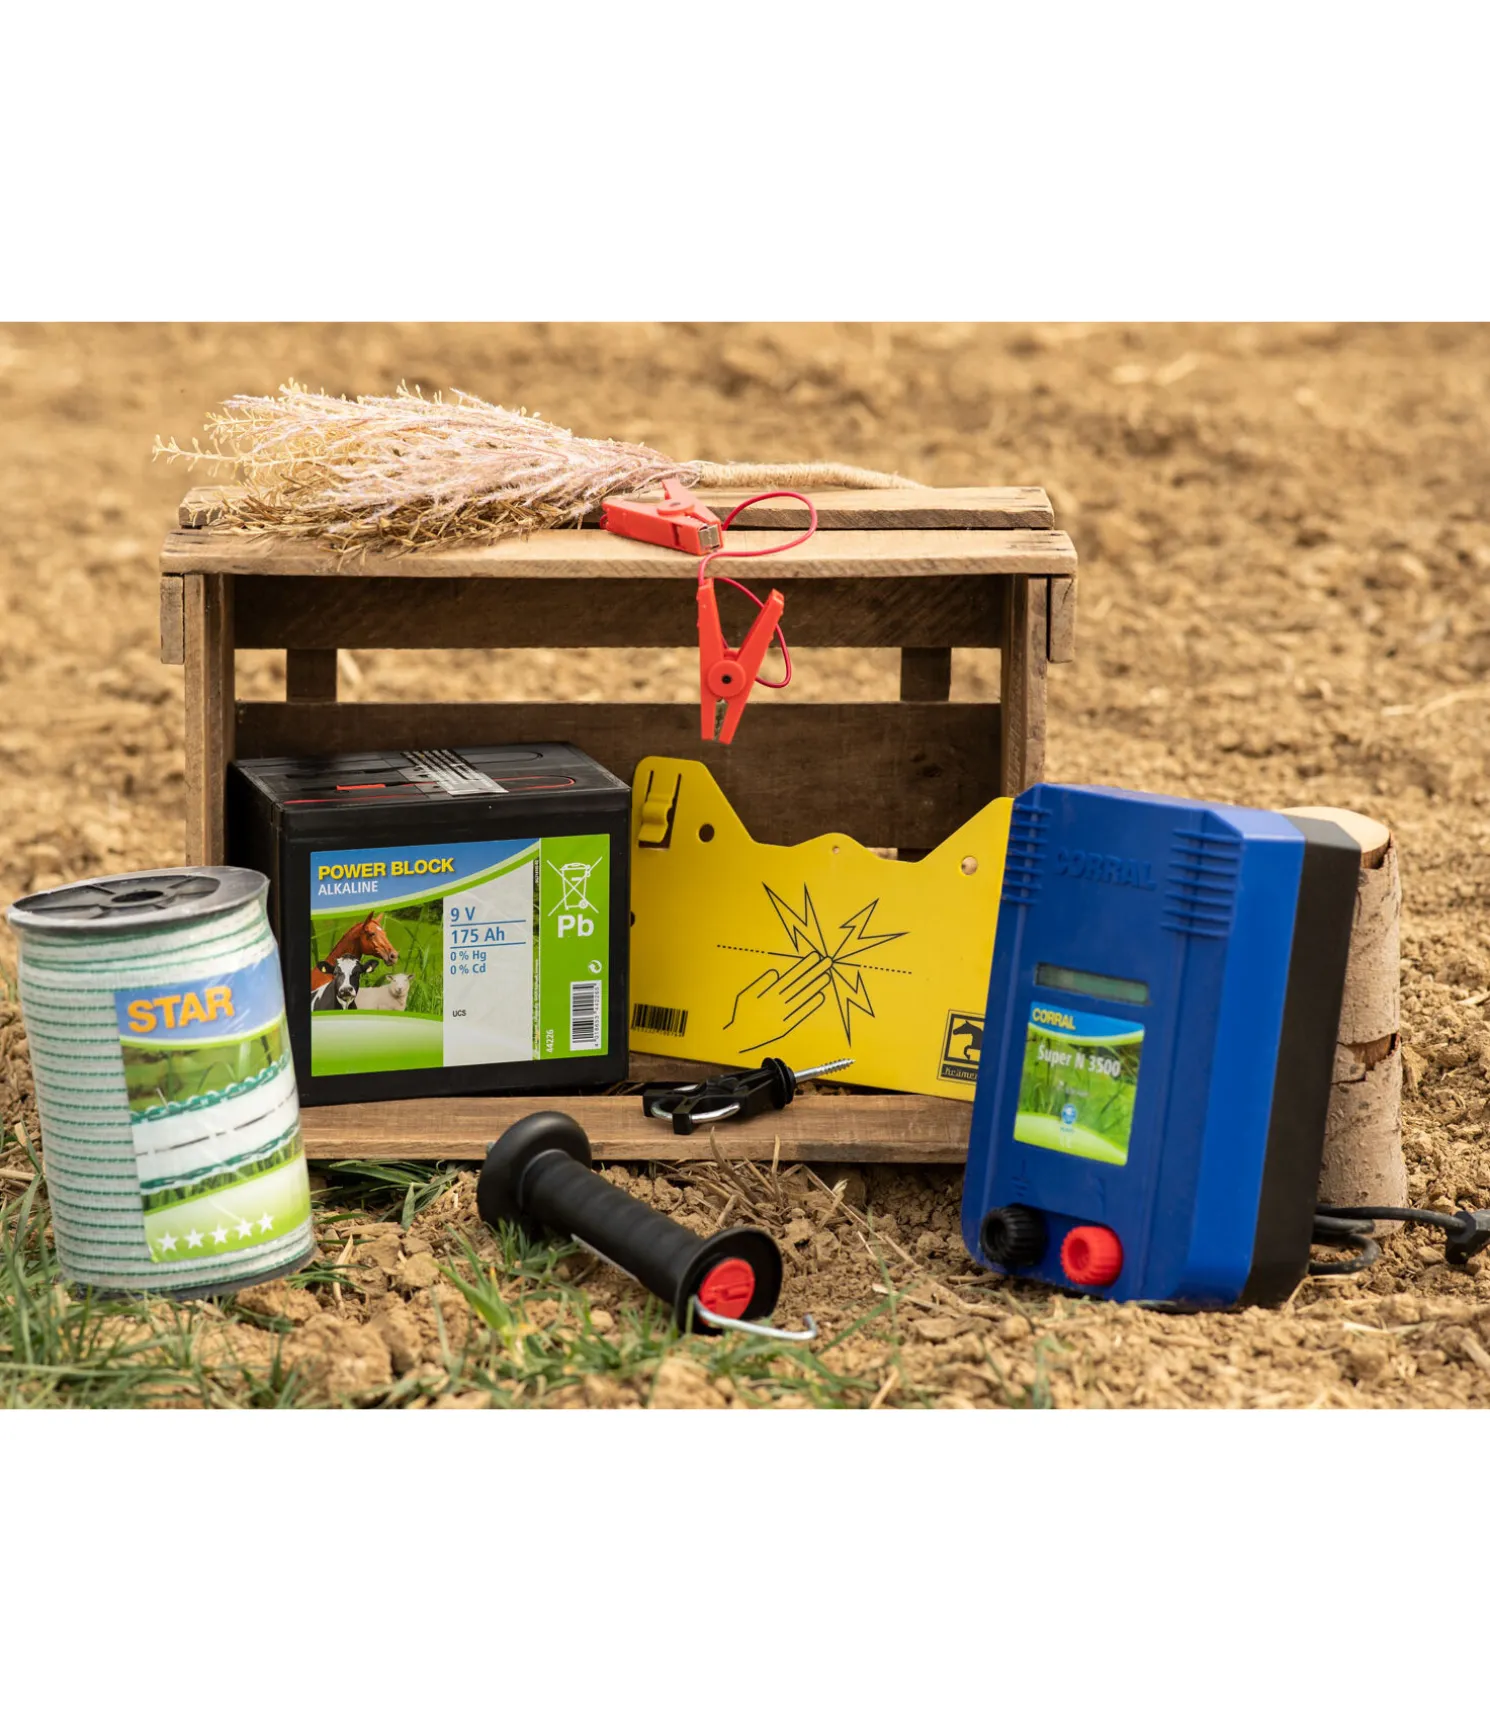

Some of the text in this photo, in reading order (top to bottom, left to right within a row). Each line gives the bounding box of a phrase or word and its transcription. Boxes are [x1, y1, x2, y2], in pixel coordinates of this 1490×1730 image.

[318, 857, 455, 881] POWER BLOCK
[318, 880, 378, 896] ALKALINE
[450, 906, 476, 922] 9 V
[450, 926, 505, 944] 175 Ah
[557, 915, 595, 938] Pb
[450, 950, 487, 964] 0 % Hg
[450, 962, 487, 975] 0 % Cd
[127, 986, 236, 1034] STAR
[452, 1008, 467, 1018] UCS
[1032, 1007, 1077, 1031] CORRAL
[545, 1028, 555, 1054] 44226
[1037, 1044, 1121, 1078] Super N 3500
